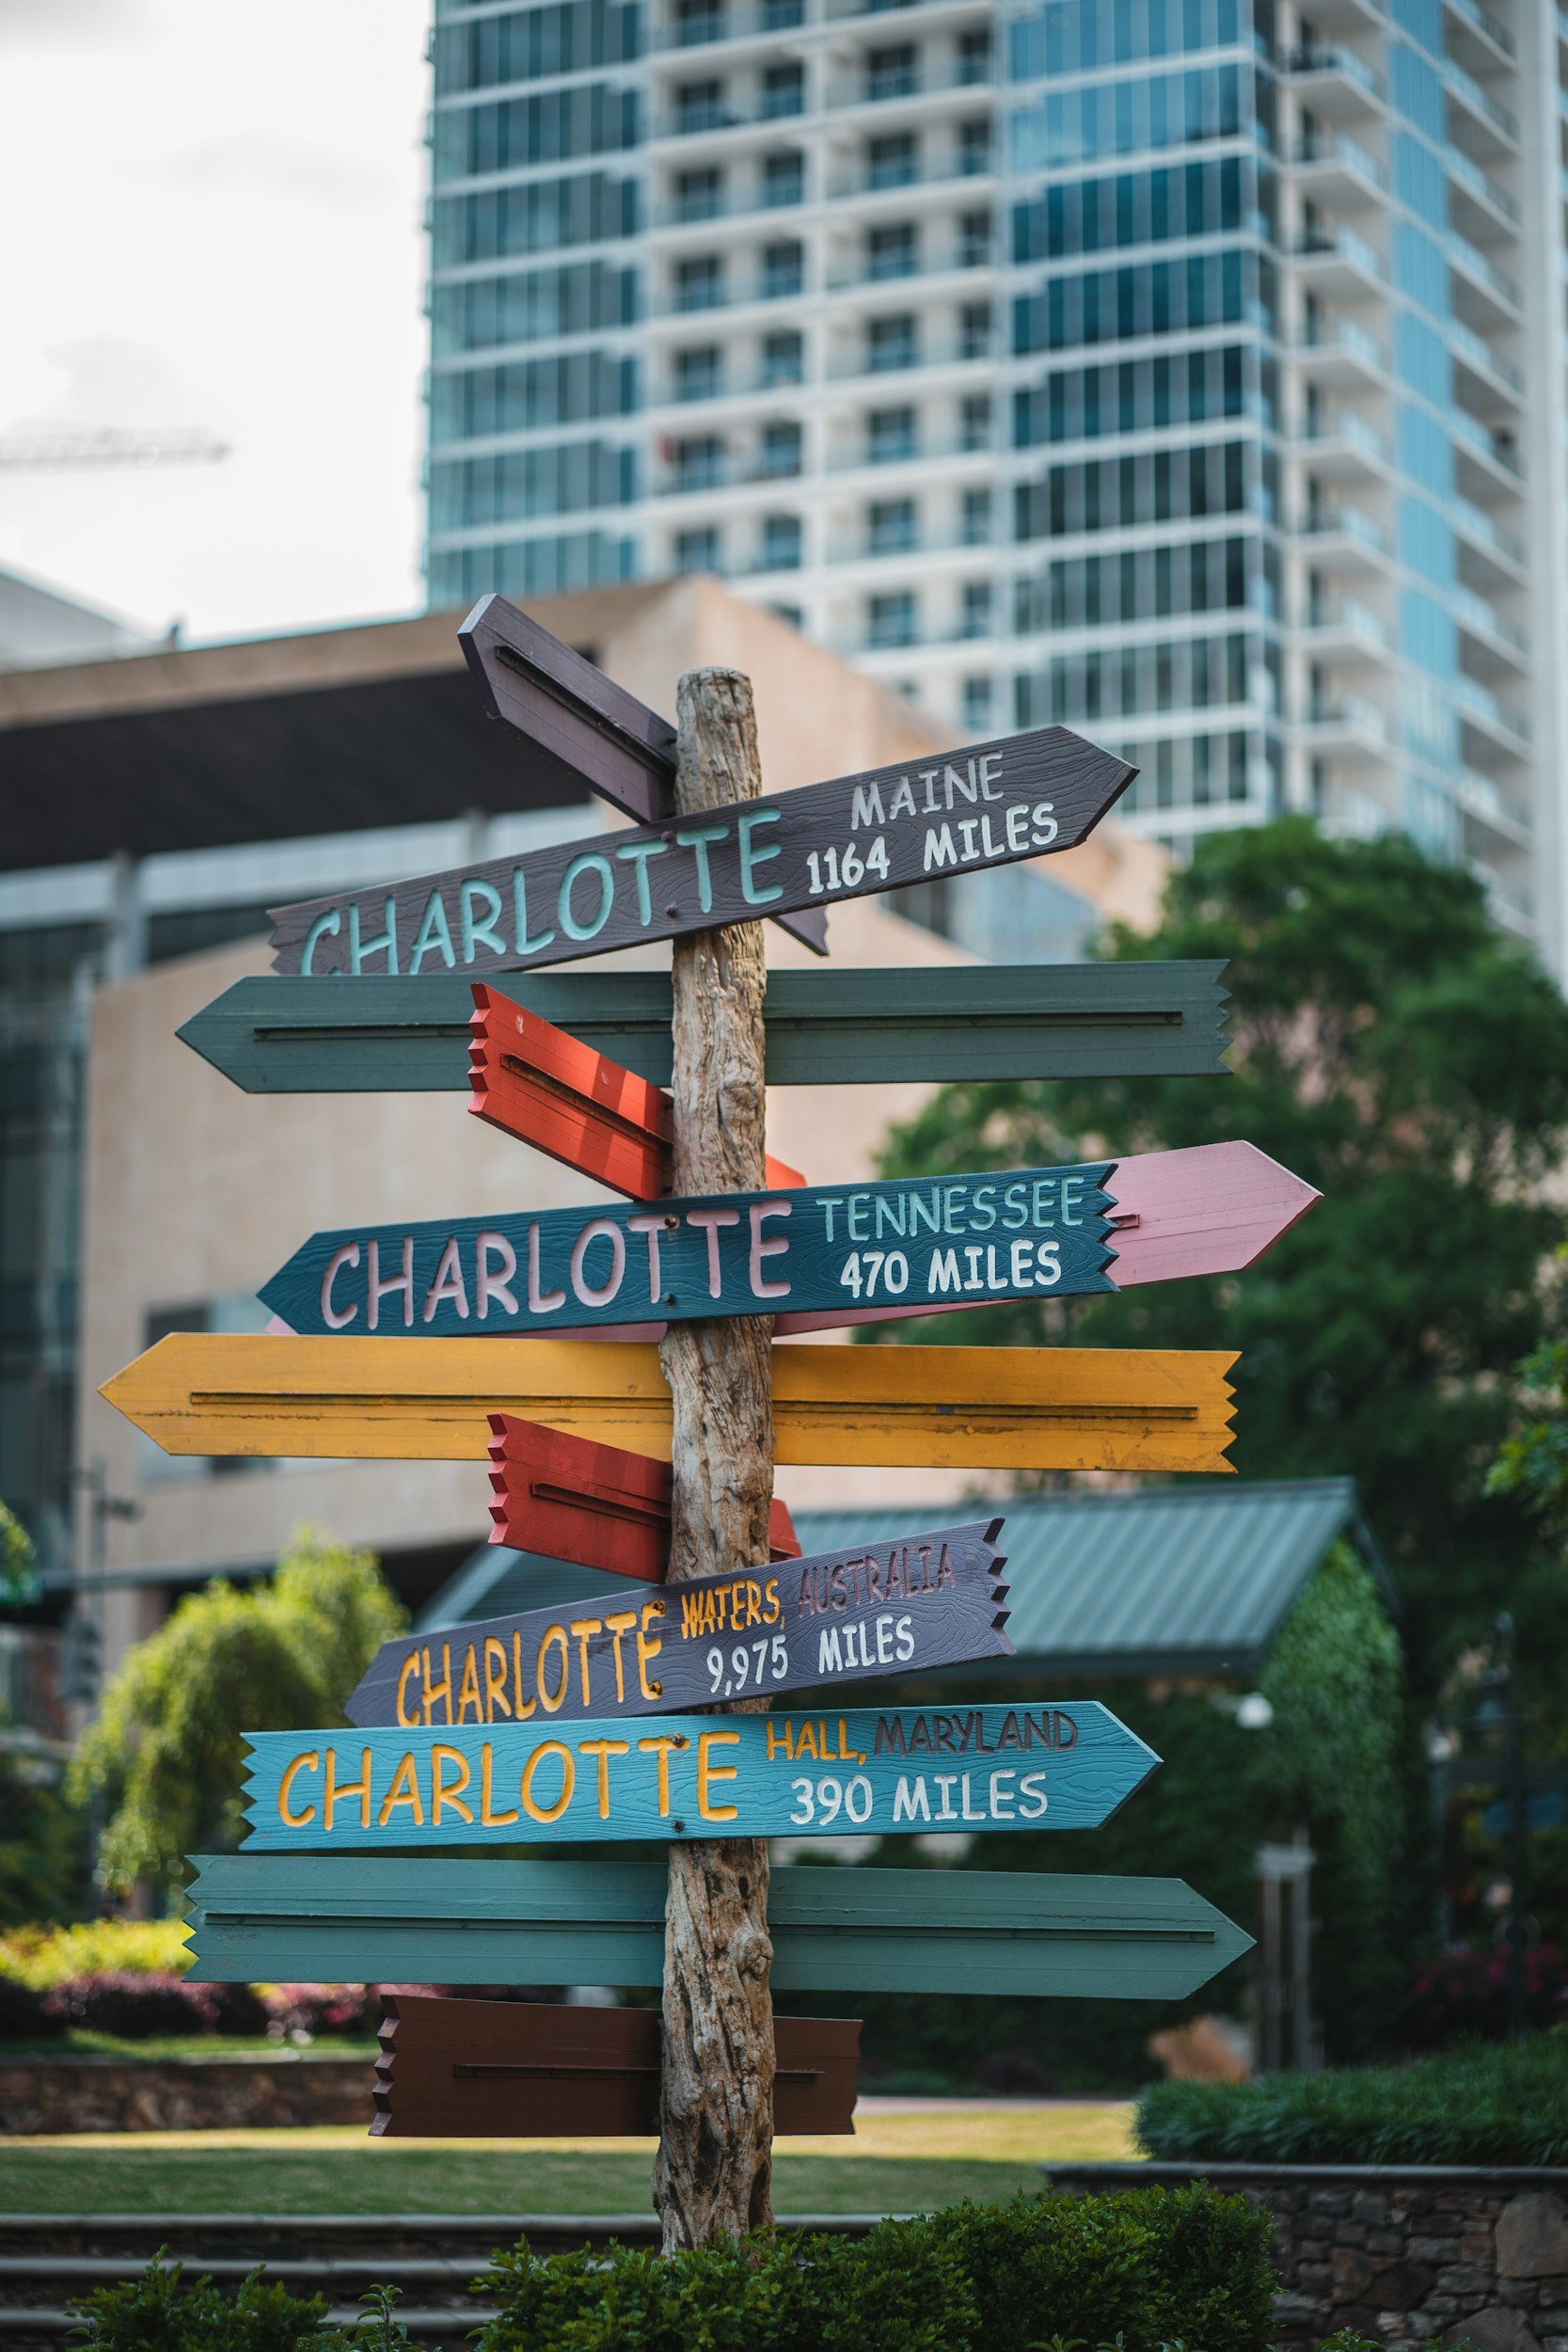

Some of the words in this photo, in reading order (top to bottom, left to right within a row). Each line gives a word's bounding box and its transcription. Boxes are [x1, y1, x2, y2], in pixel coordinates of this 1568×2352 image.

[850, 751, 1005, 830] MAINE
[301, 806, 784, 975] CHARLOTTE
[806, 835, 891, 894] 1164
[923, 803, 1058, 871] MILES
[816, 1174, 1085, 1242] TENNESSEE
[320, 1198, 793, 1330] CHARLOTTE
[840, 1250, 910, 1298] 470
[927, 1238, 1062, 1294] MILES
[680, 1577, 785, 1640] WATERS,
[798, 1543, 957, 1618] AUSTRALIA
[396, 1599, 667, 1726] CHARLOTTE
[705, 1634, 789, 1696] 9,975
[818, 1614, 915, 1674] MILES
[277, 1730, 741, 1831] CHARLOTTE
[767, 1716, 867, 1766] HALL,
[874, 1709, 1078, 1758] MARYLAND
[790, 1773, 873, 1826] 390
[893, 1769, 1049, 1822] MILES
